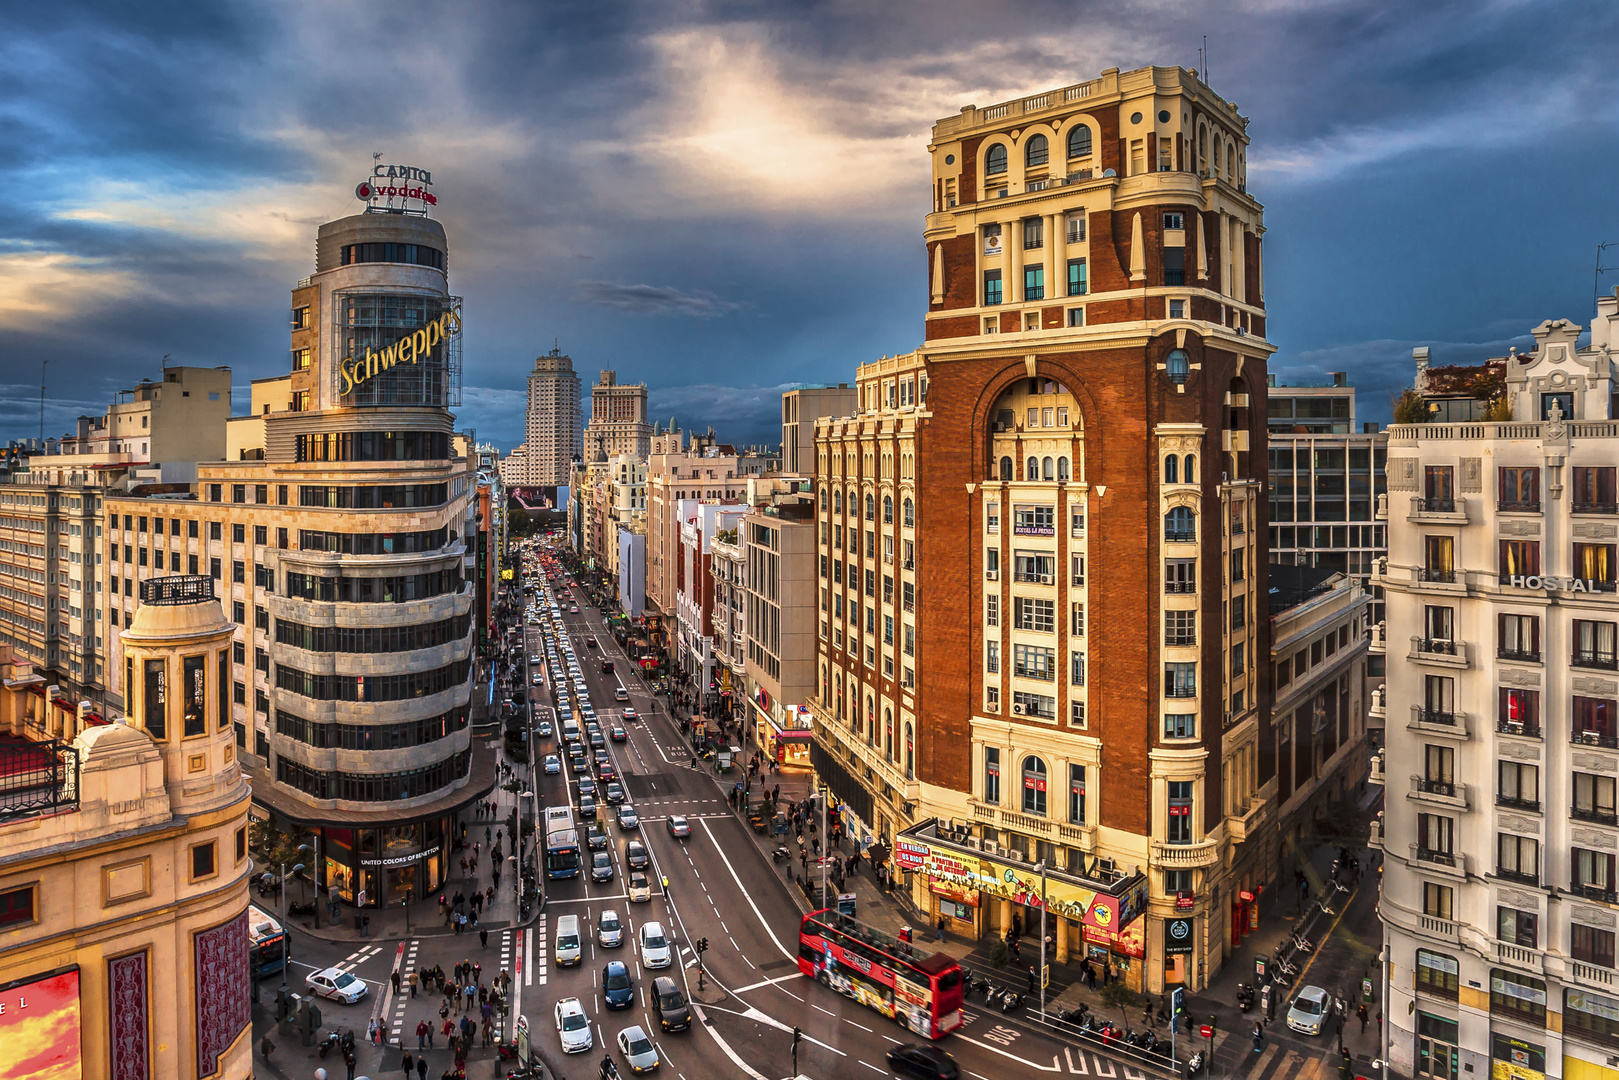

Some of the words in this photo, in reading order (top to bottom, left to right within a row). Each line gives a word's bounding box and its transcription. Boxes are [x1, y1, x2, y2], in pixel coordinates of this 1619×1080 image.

[374, 165, 433, 185] CAPITOL
[376, 184, 437, 206] vodafone
[339, 304, 461, 397] Schweppes
[479, 534, 487, 579] HOTEL
[1510, 574, 1602, 594] HOSTAL
[479, 628, 487, 654] REX
[383, 856, 406, 865] COLORS
[415, 846, 440, 859] BENETTON
[901, 842, 907, 850] EN
[908, 844, 928, 854] VERDAD
[902, 852, 909, 860] OS
[910, 855, 922, 863] DIGO
[936, 857, 953, 867] PARTIR
[953, 861, 962, 869] DEL
[983, 1025, 1021, 1046] BUS
